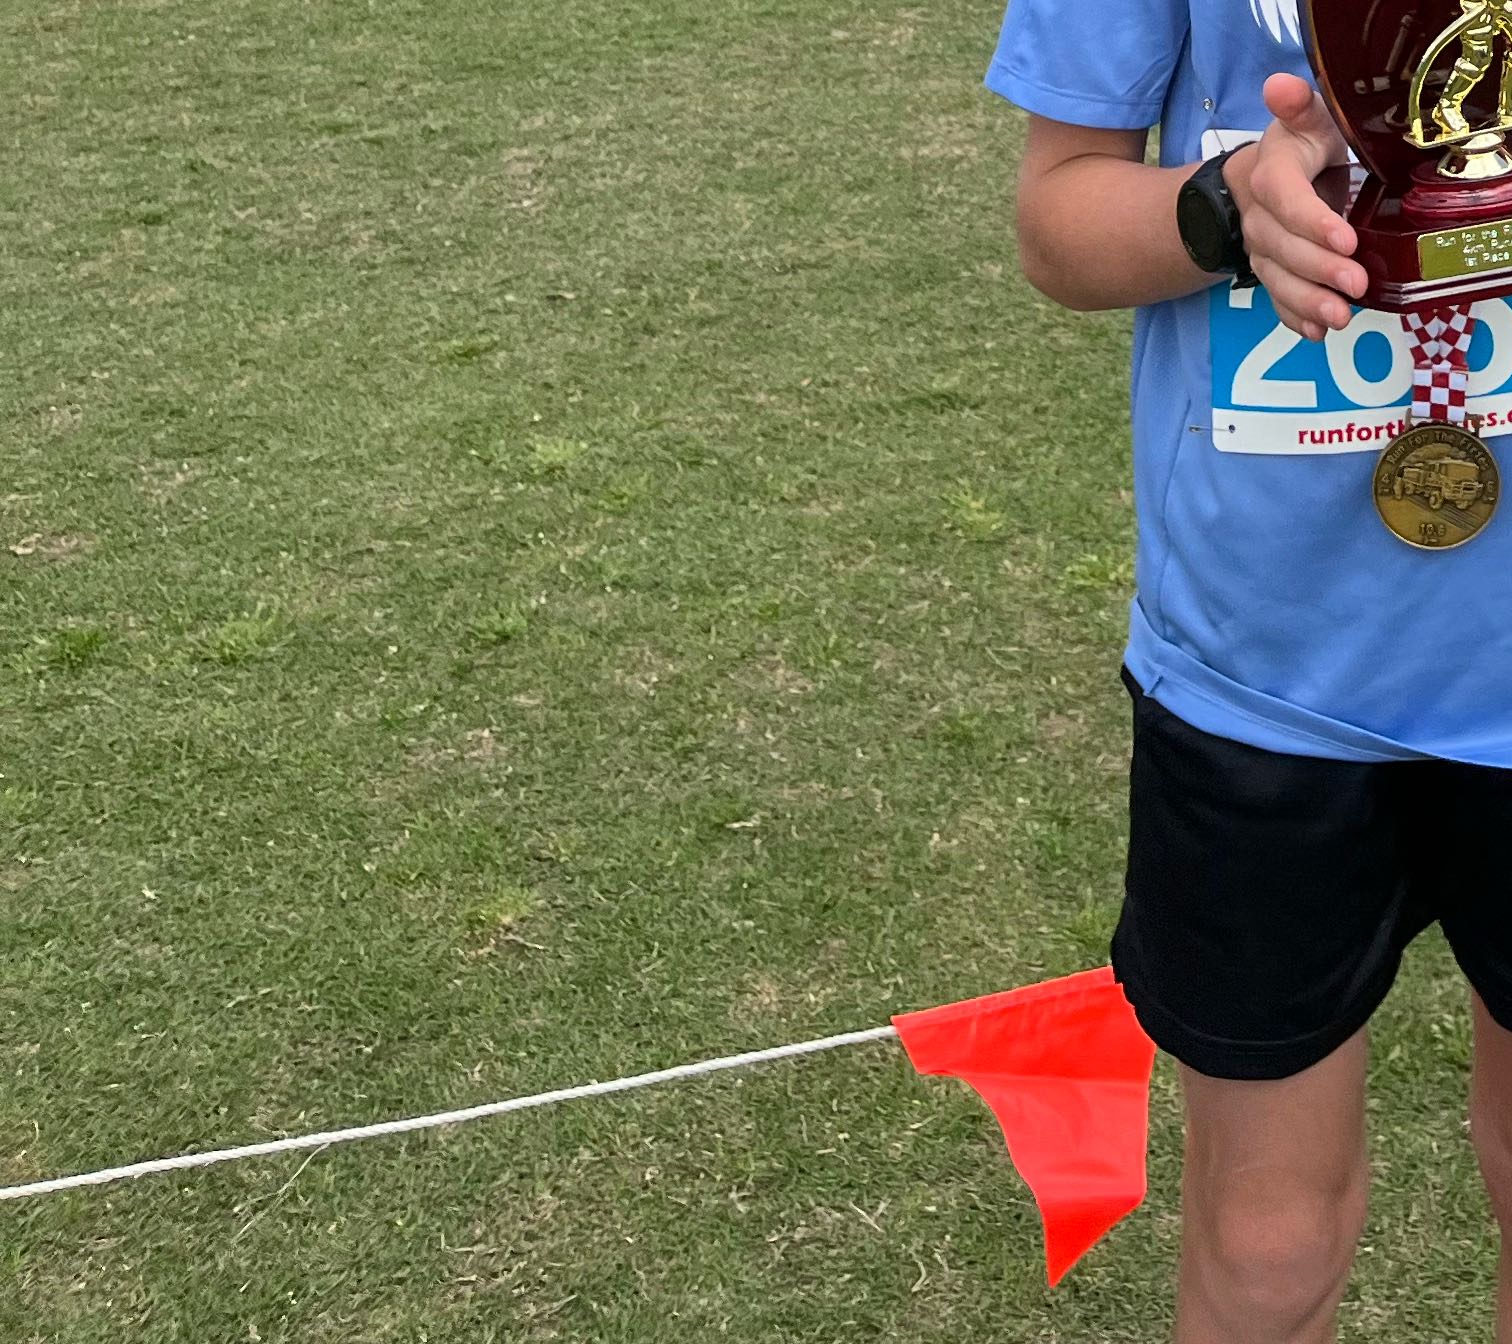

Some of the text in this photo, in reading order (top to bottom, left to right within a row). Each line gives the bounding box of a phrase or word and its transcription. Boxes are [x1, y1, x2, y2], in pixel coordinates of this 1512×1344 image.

[1436, 236, 1456, 247] Run
[1461, 232, 1475, 242] for
[1481, 229, 1498, 240] the
[1408, 433, 1429, 447] For
